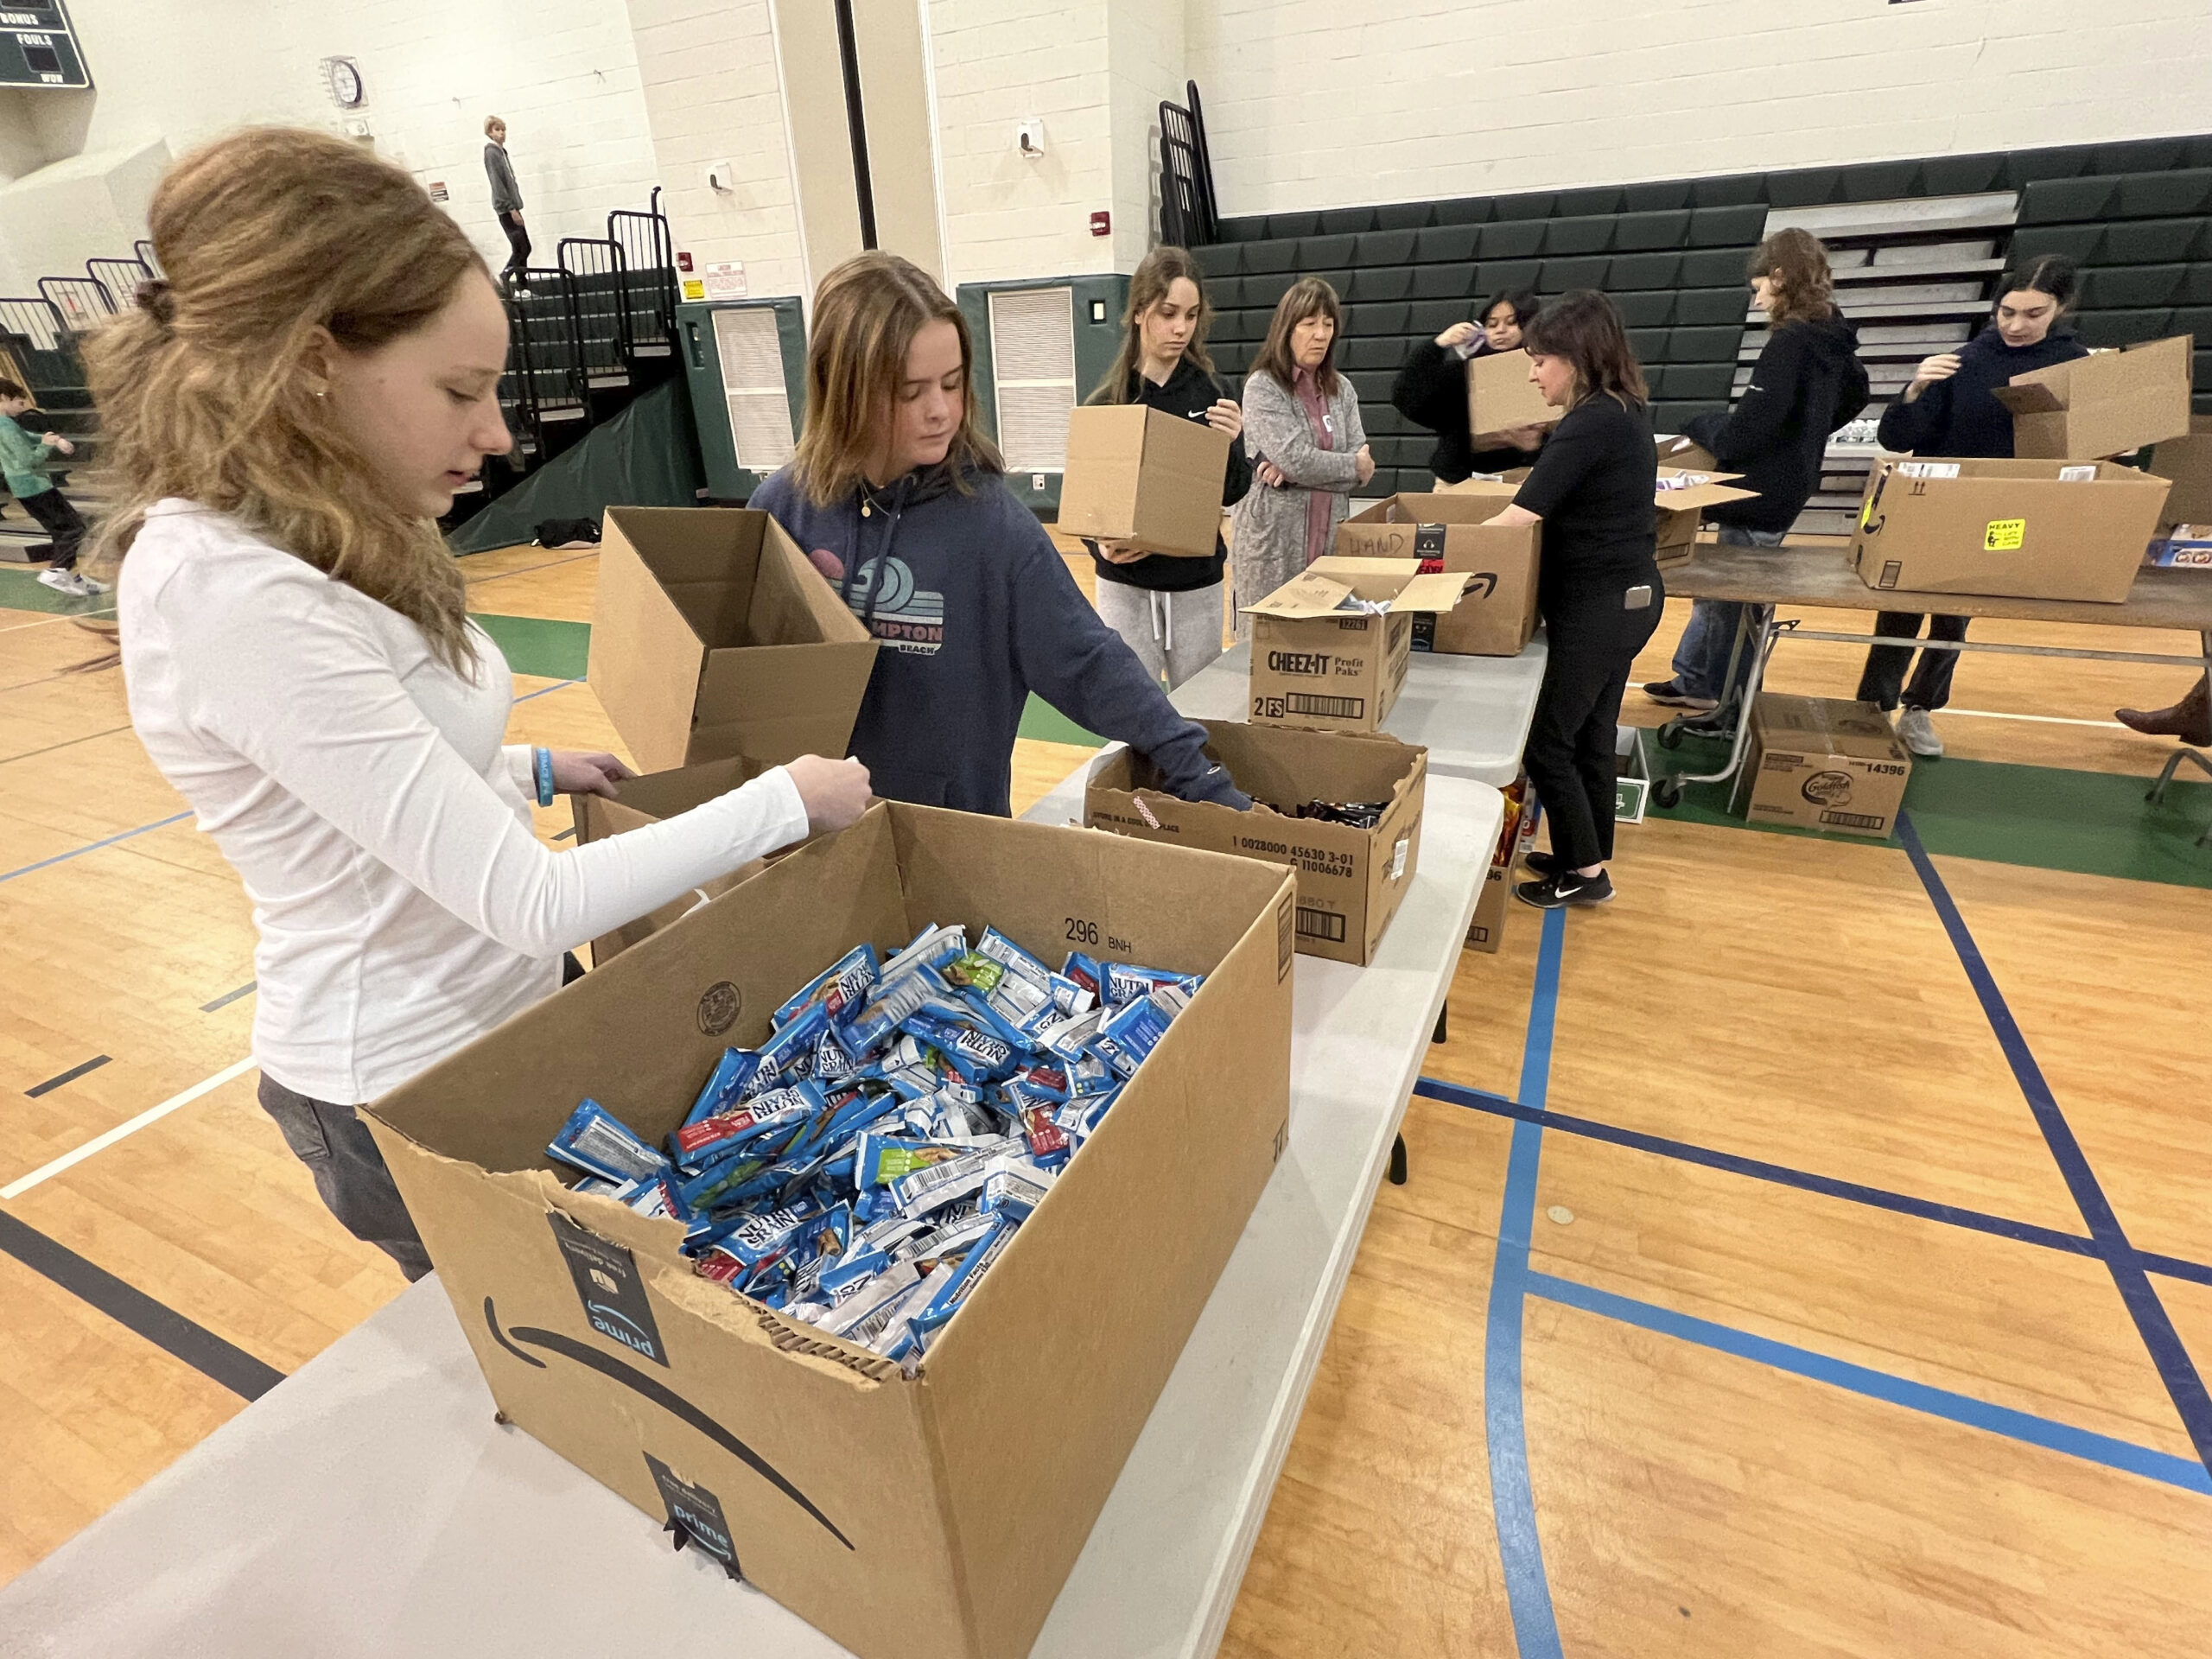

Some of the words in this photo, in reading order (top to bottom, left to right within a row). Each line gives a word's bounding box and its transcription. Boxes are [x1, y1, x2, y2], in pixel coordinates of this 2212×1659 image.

[0, 13, 39, 25] BONUS
[16, 34, 53, 46] FOULS
[40, 73, 64, 83] WON
[1349, 532, 1404, 555] HAND
[872, 621, 943, 642] MPTON
[899, 644, 935, 655] BEACH
[1334, 657, 1364, 668] Profit
[1334, 666, 1360, 677] Paks
[1254, 697, 1264, 716] 2
[1267, 698, 1283, 718] FS
[1866, 762, 1906, 777] 14396
[1808, 779, 1850, 793] Goldfish
[1241, 836, 1287, 855] 0028000
[1290, 846, 1325, 862] 45630
[1328, 852, 1354, 866] 3-01
[1302, 860, 1353, 878] 11006678
[1065, 918, 1099, 945] 296
[1108, 937, 1132, 953] BNH
[958, 1034, 1005, 1062] NUTRI
[967, 1029, 1008, 1056] GRAIN
[753, 1086, 800, 1115] GRAIN
[756, 1095, 805, 1120] NUTRI
[950, 1277, 972, 1305] Nutrition
[969, 1261, 986, 1280] Facts
[592, 1315, 656, 1359] prime
[673, 1503, 728, 1548] prime
